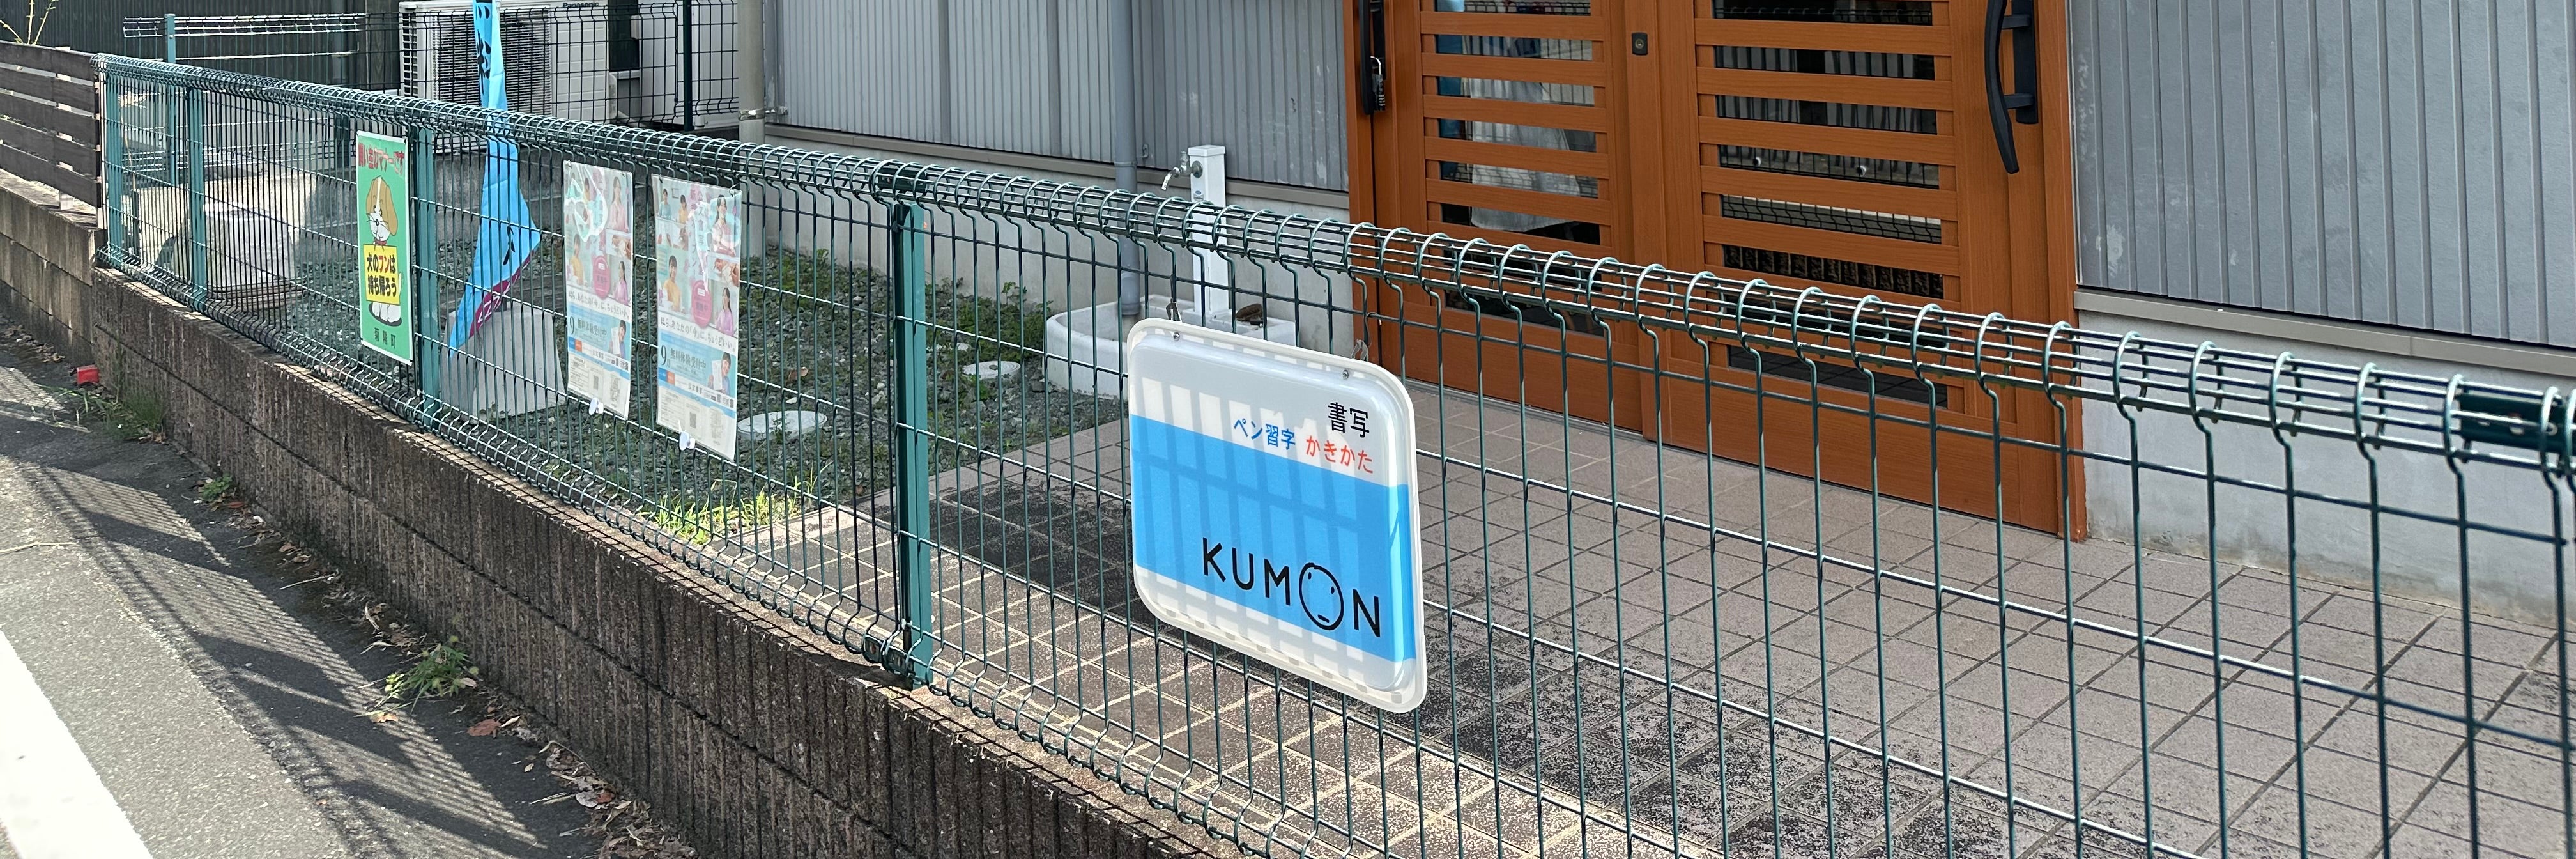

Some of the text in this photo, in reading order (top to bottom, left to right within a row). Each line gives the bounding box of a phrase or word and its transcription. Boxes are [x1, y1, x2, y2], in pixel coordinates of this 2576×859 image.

[367, 252, 396, 274] 犬のフンは
[367, 275, 397, 297] 持ち帰ろう
[1233, 418, 1296, 450] ペン習字
[1327, 401, 1370, 438] 書写
[1305, 435, 1374, 474] かきかた
[1202, 537, 1381, 638] KUMON
